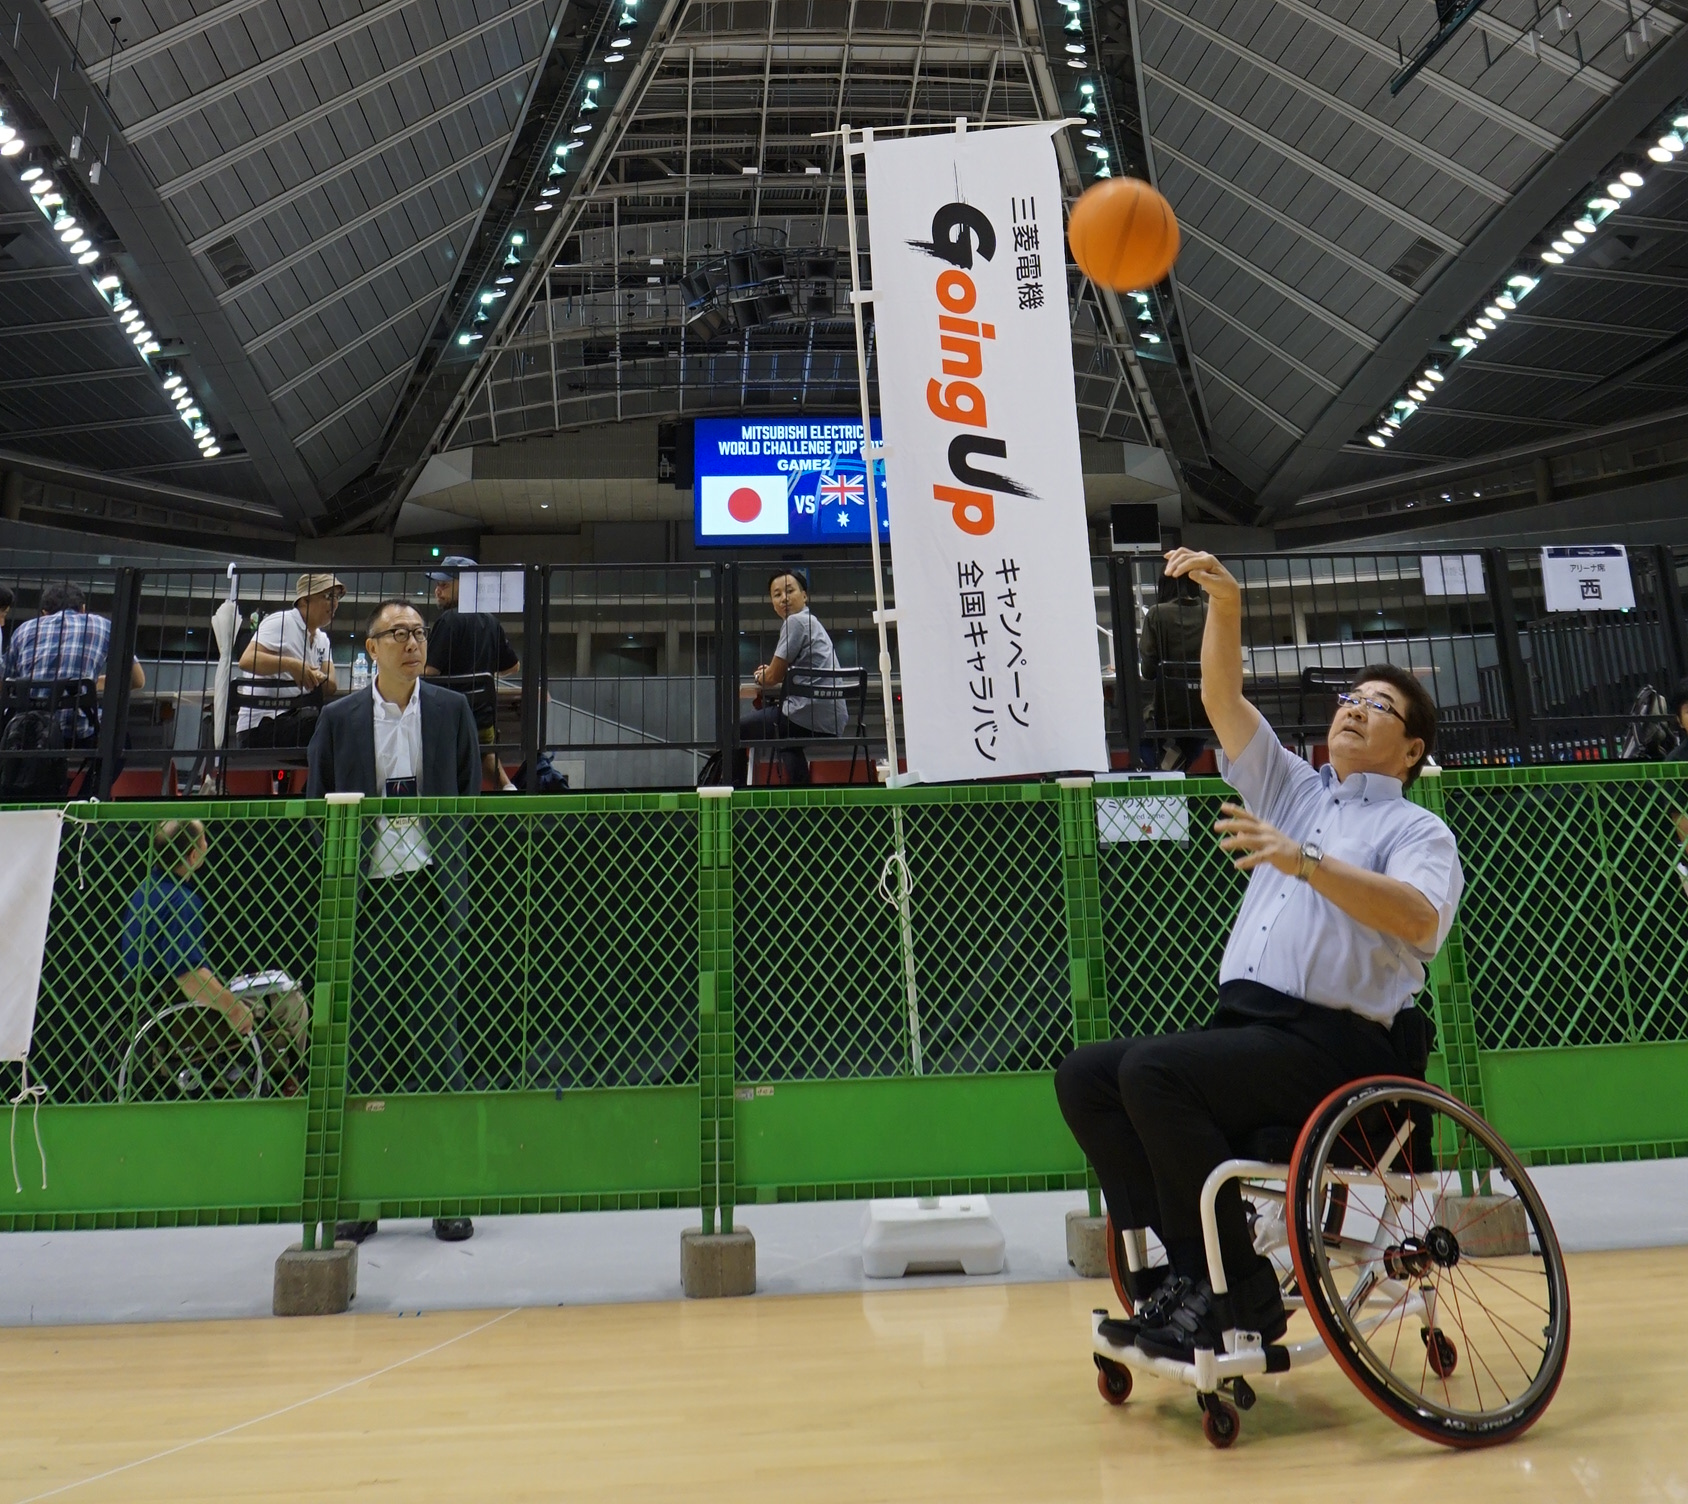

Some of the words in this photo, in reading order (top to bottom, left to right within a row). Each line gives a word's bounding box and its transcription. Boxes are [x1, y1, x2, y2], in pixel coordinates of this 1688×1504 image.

[1011, 196, 1045, 310] 三菱電機
[906, 200, 997, 429] Going
[718, 441, 760, 456] WORLD
[763, 441, 831, 455] CHALLENGE
[834, 440, 857, 454] CUP
[741, 425, 807, 440] MITSUBISHI
[810, 425, 864, 439] ELECTRIC
[777, 459, 831, 471] GAME2
[933, 432, 1042, 536] Up
[794, 495, 816, 514] VS
[1578, 579, 1603, 600] 西
[956, 560, 997, 762] 全国キャラバン
[995, 558, 1030, 728] キャンペーン
